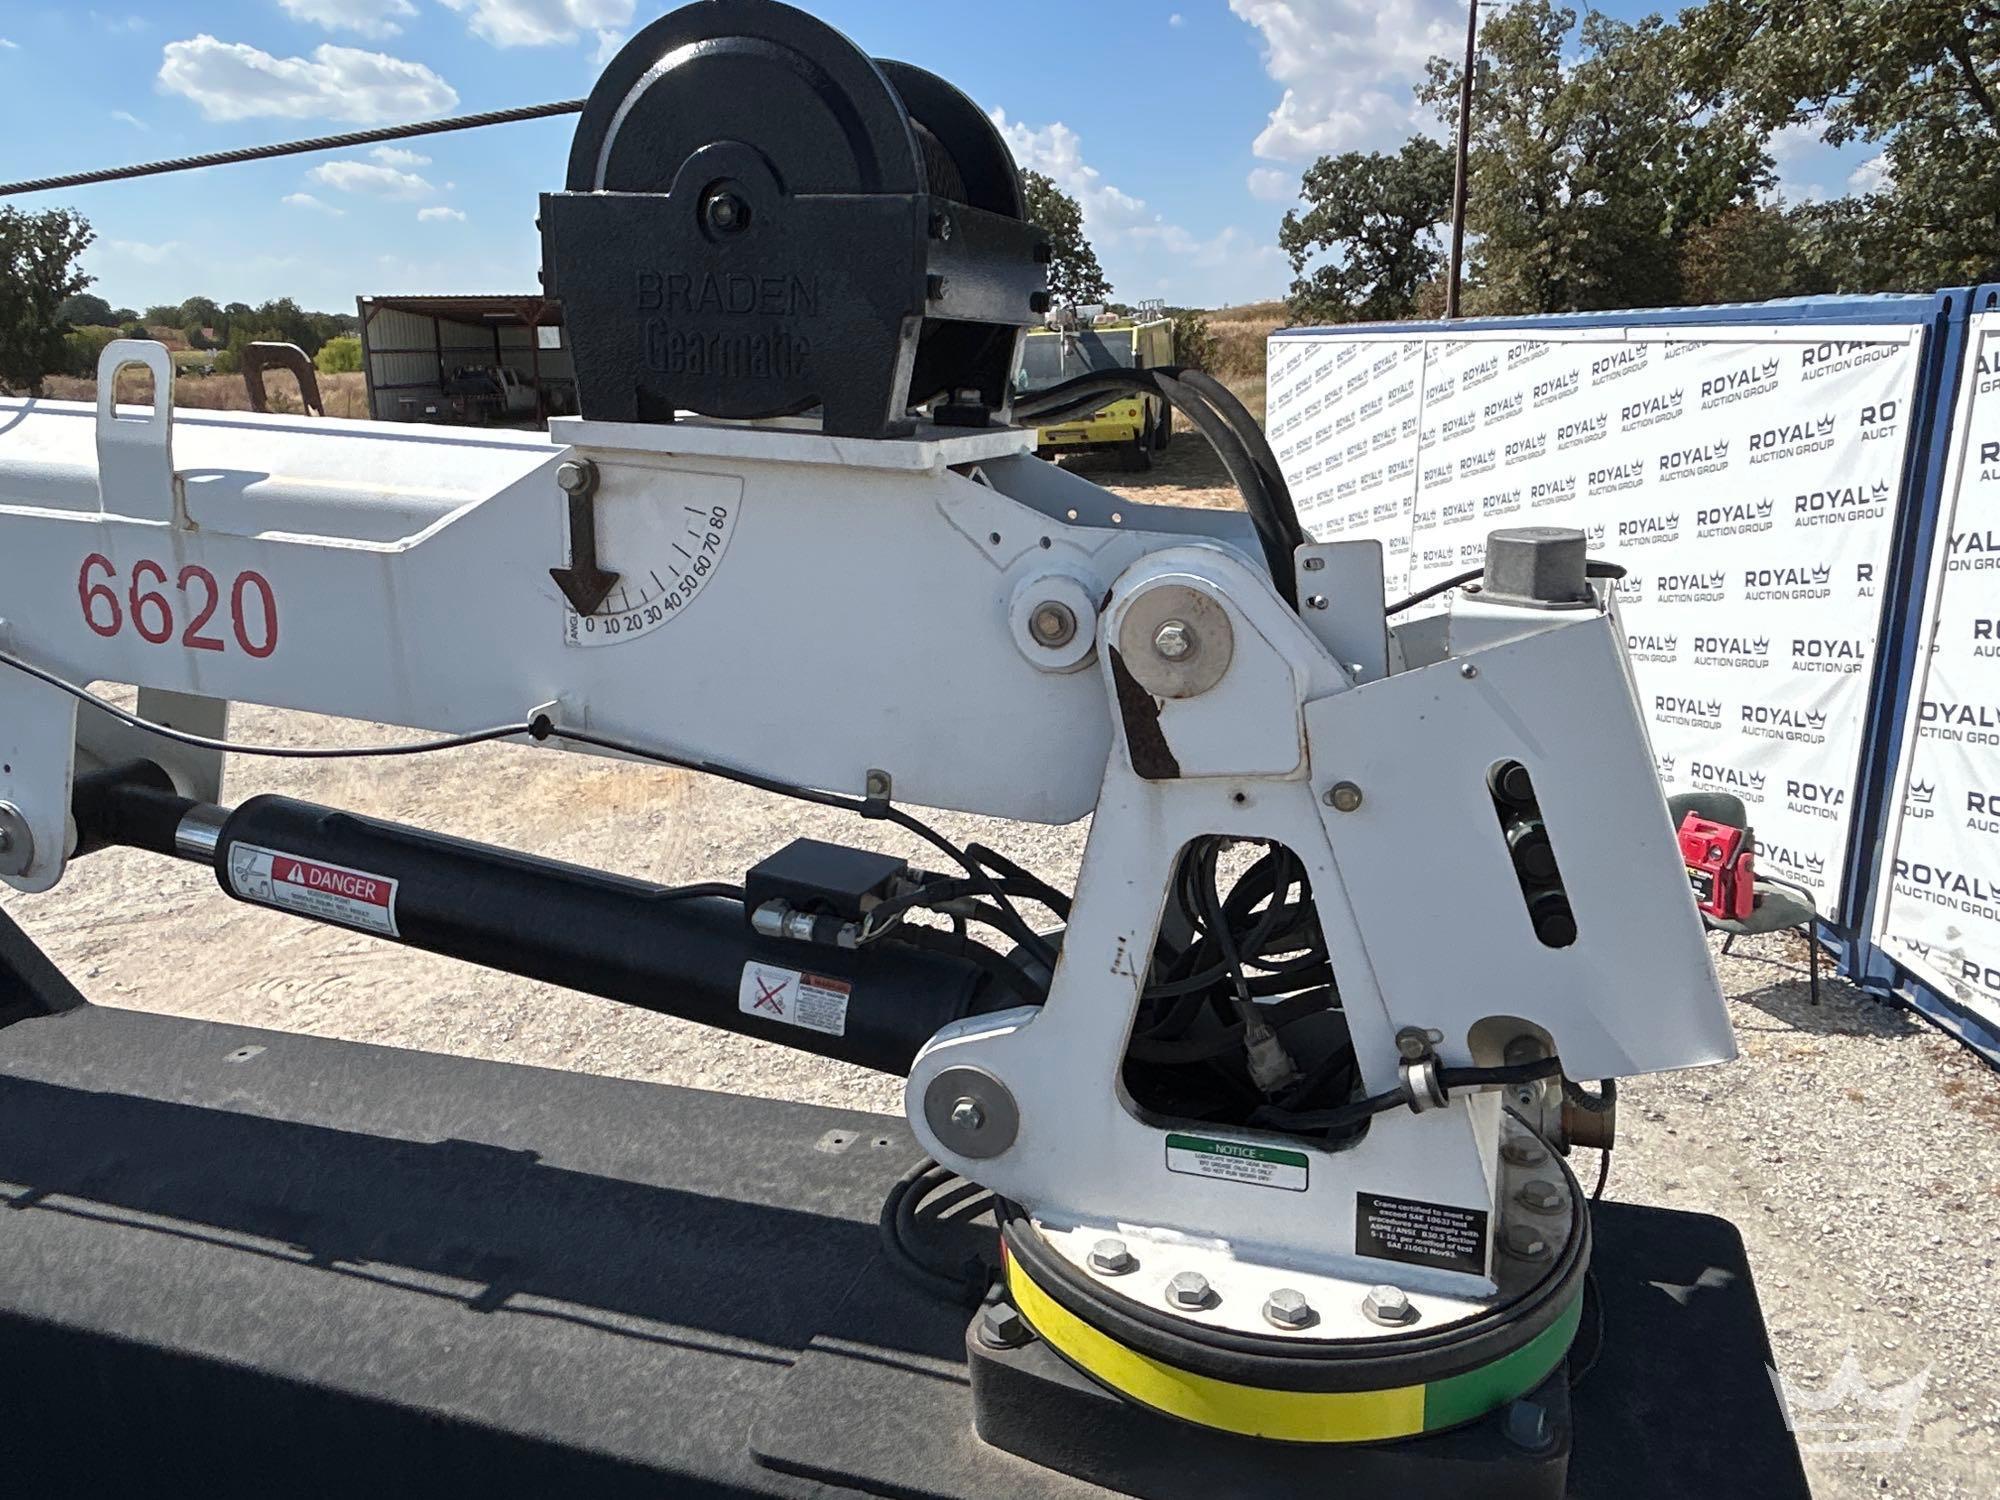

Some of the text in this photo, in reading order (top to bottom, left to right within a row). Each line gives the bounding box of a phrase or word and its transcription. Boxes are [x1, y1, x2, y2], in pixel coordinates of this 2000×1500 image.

[637, 270, 820, 317] BRADEN
[645, 317, 812, 380] Gearmatic
[1463, 362, 1490, 382] ROYAL
[1592, 348, 1635, 376] ROYAL
[1801, 343, 1899, 382] AUCTION GROUP
[1592, 359, 1648, 387] AUCTION GROUP
[1701, 366, 1761, 398] ROYAL
[1533, 375, 1568, 399] ROYAL
[1533, 386, 1579, 408] AUCTION GROUP
[1701, 380, 1779, 411] AUCTION GROUP
[1484, 398, 1514, 418] ROYAL
[1621, 395, 1669, 421] ROYAL
[1442, 413, 1468, 433] ROYAL
[1557, 418, 1596, 441] ROYAL
[1621, 408, 1683, 433] AUCTION GROUP
[1557, 431, 1607, 451] AUCTION GROUP
[1749, 421, 1815, 451] ROYAL
[1505, 437, 1536, 457] ROYAL
[1749, 438, 1835, 465] AUCTION GROUP
[1460, 452, 1488, 470] ROYAL
[1660, 446, 1713, 470] ROYAL
[1588, 464, 1631, 485] ROYAL
[1659, 461, 1729, 482] AUCTION GROUP
[1531, 479, 1565, 498] ROYAL
[1588, 478, 1643, 496] AUCTION GROUP
[1443, 501, 1467, 517] ROYAL
[1483, 493, 1513, 509] ROYAL
[1795, 486, 1870, 513] ROYAL
[1697, 503, 1756, 526] ROYAL
[1795, 507, 1886, 527] AUCTION GROU
[1618, 517, 1665, 536] ROYAL
[1697, 521, 1773, 539] AUCTION GROUP
[1619, 535, 1650, 547] AUCTION
[1651, 532, 1679, 544] GROUP
[1424, 549, 1447, 561] ROYAL
[585, 505, 727, 634] 0 10 20 30 40 50 60 70 80
[1745, 567, 1811, 587] ROYAL
[1658, 574, 1709, 591] ROYAL
[1658, 592, 1725, 603] AUCTION GROUP
[1745, 588, 1831, 601] AUCTION GROUP
[78, 552, 279, 659] 6620
[1694, 637, 1752, 654] ROYAL
[1792, 639, 1865, 659] ROYAL
[1630, 653, 1650, 662] TION
[1694, 657, 1769, 669] AUCTION GROUP
[1792, 661, 1842, 673] AUCTION
[1655, 696, 1706, 716] ROYAL
[1656, 714, 1722, 730] AUCTION GROUP
[1741, 705, 1806, 728] ROYAL
[1741, 725, 1825, 744] AUCTION GROUP
[1691, 762, 1749, 787] ROYAL
[1787, 802, 1838, 821] AUCTION
[309, 868, 377, 901] DANGER
[1786, 870, 1825, 888] GROUP
[1894, 858, 1988, 901] ROYAL
[1894, 882, 1958, 909] AUCTION
[1215, 1144, 1257, 1158] NOTICE
[1373, 1199, 1397, 1209] Crane
[1398, 1203, 1432, 1215] certified
[1443, 1210, 1464, 1220] meet
[1379, 1209, 1408, 1219] exceed
[1408, 1213, 1424, 1222] SAE
[1452, 1220, 1468, 1229] test
[1368, 1215, 1480, 1238] procedures and comply with
[1370, 1222, 1416, 1237] ASME/ANSI
[1446, 1234, 1477, 1246] Section
[1386, 1241, 1402, 1250] SAE
[1400, 1236, 1413, 1245] per
[1414, 1237, 1446, 1249] method
[1456, 1245, 1473, 1254] test
